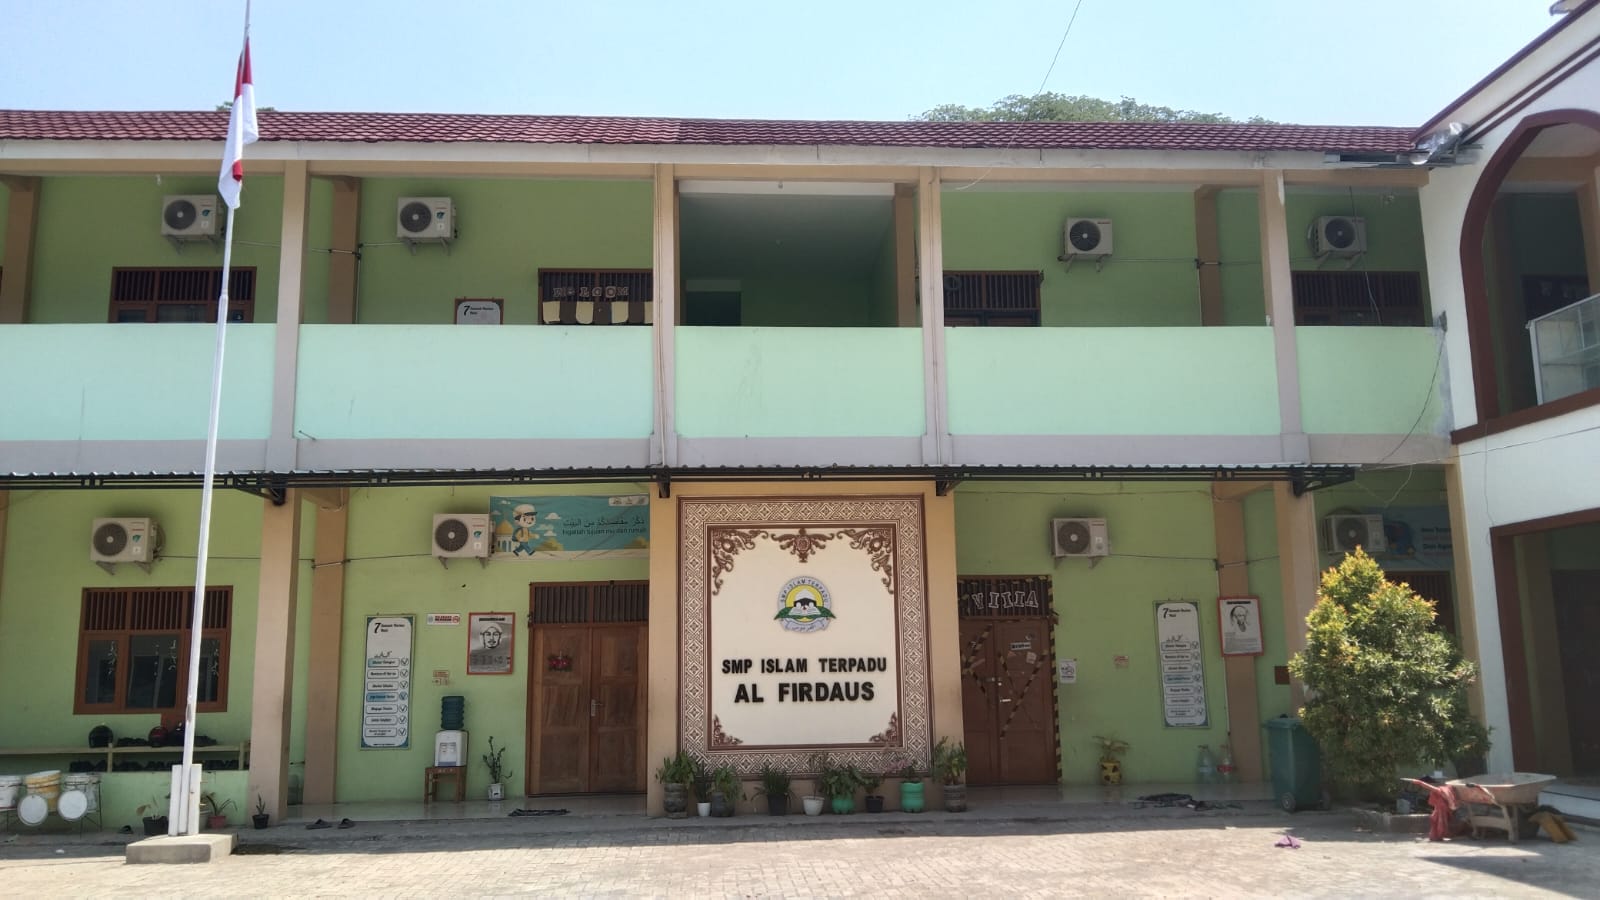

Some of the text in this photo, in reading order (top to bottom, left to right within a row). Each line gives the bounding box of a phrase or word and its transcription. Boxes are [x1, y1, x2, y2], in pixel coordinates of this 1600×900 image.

[463, 305, 471, 316] 7
[1162, 607, 1169, 619] 7
[374, 622, 382, 634] 7
[721, 656, 888, 675] SMP ISLAM TERPADU
[734, 682, 875, 703] AL FIRDAUS
